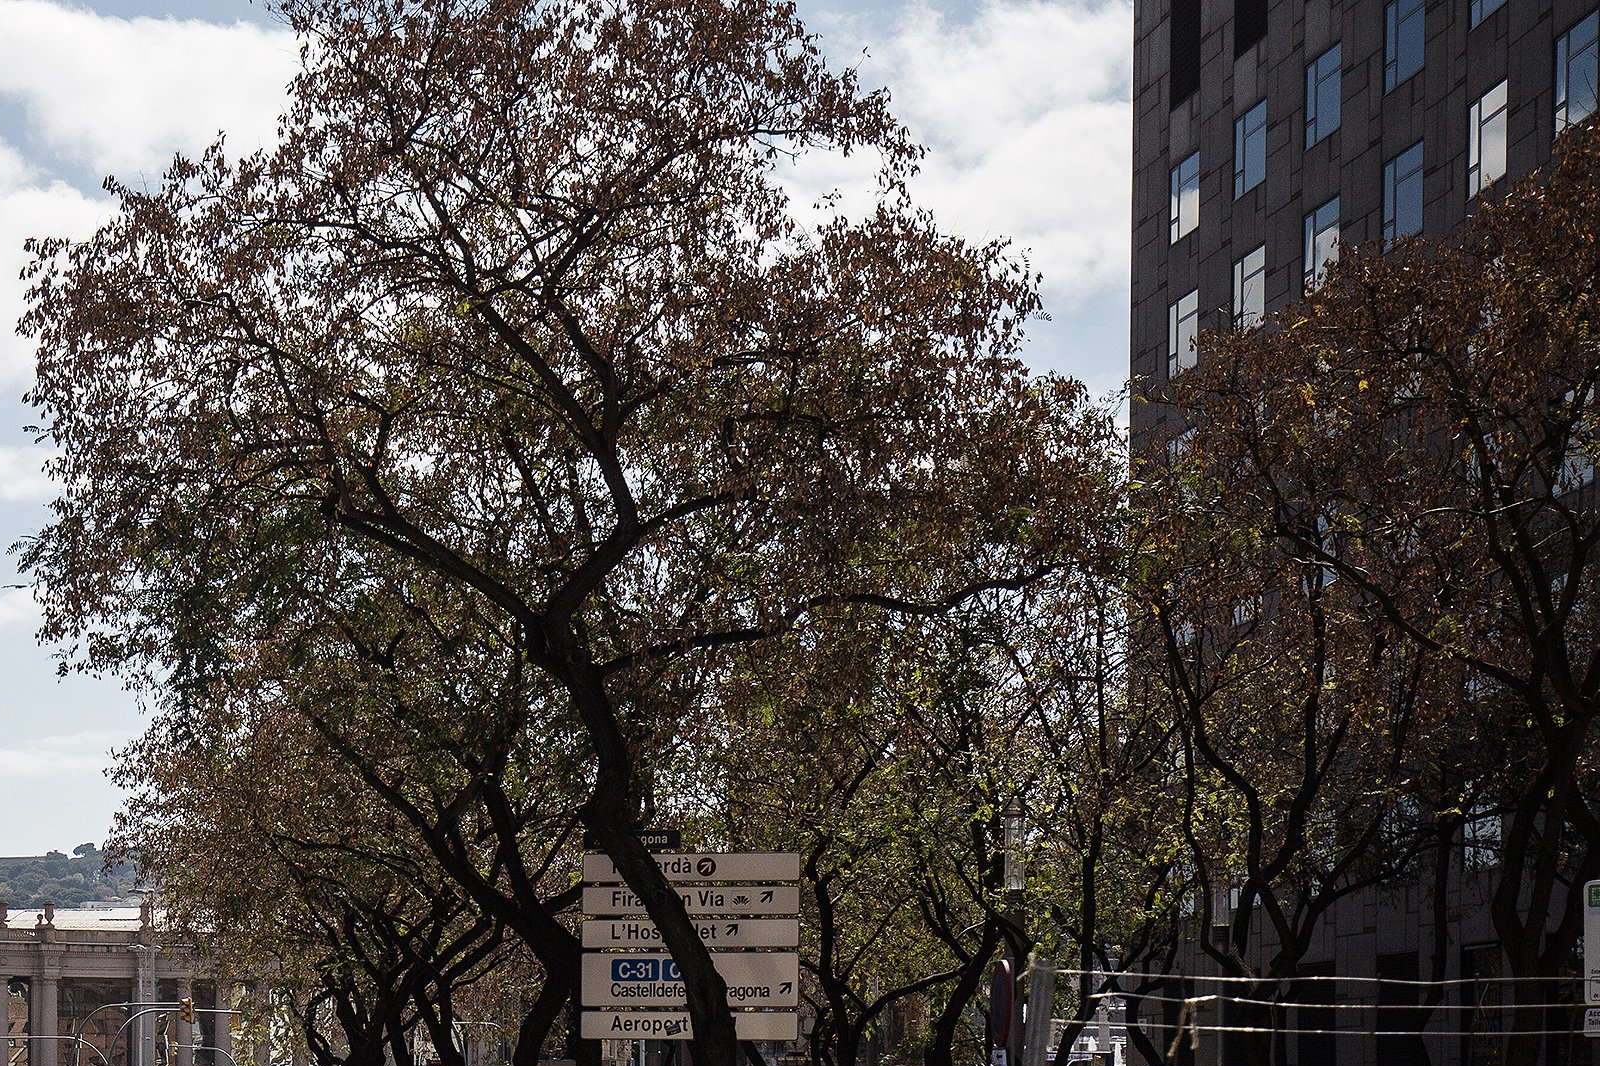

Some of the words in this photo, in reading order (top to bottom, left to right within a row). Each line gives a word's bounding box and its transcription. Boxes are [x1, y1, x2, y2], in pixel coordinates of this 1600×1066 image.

[640, 835, 668, 846] gona
[658, 857, 691, 874] erdà
[698, 891, 725, 907] Via
[611, 924, 717, 941] L'Hoslet
[618, 963, 653, 978] C-31
[610, 983, 686, 998] Castelldefe
[725, 985, 770, 1001] ragona
